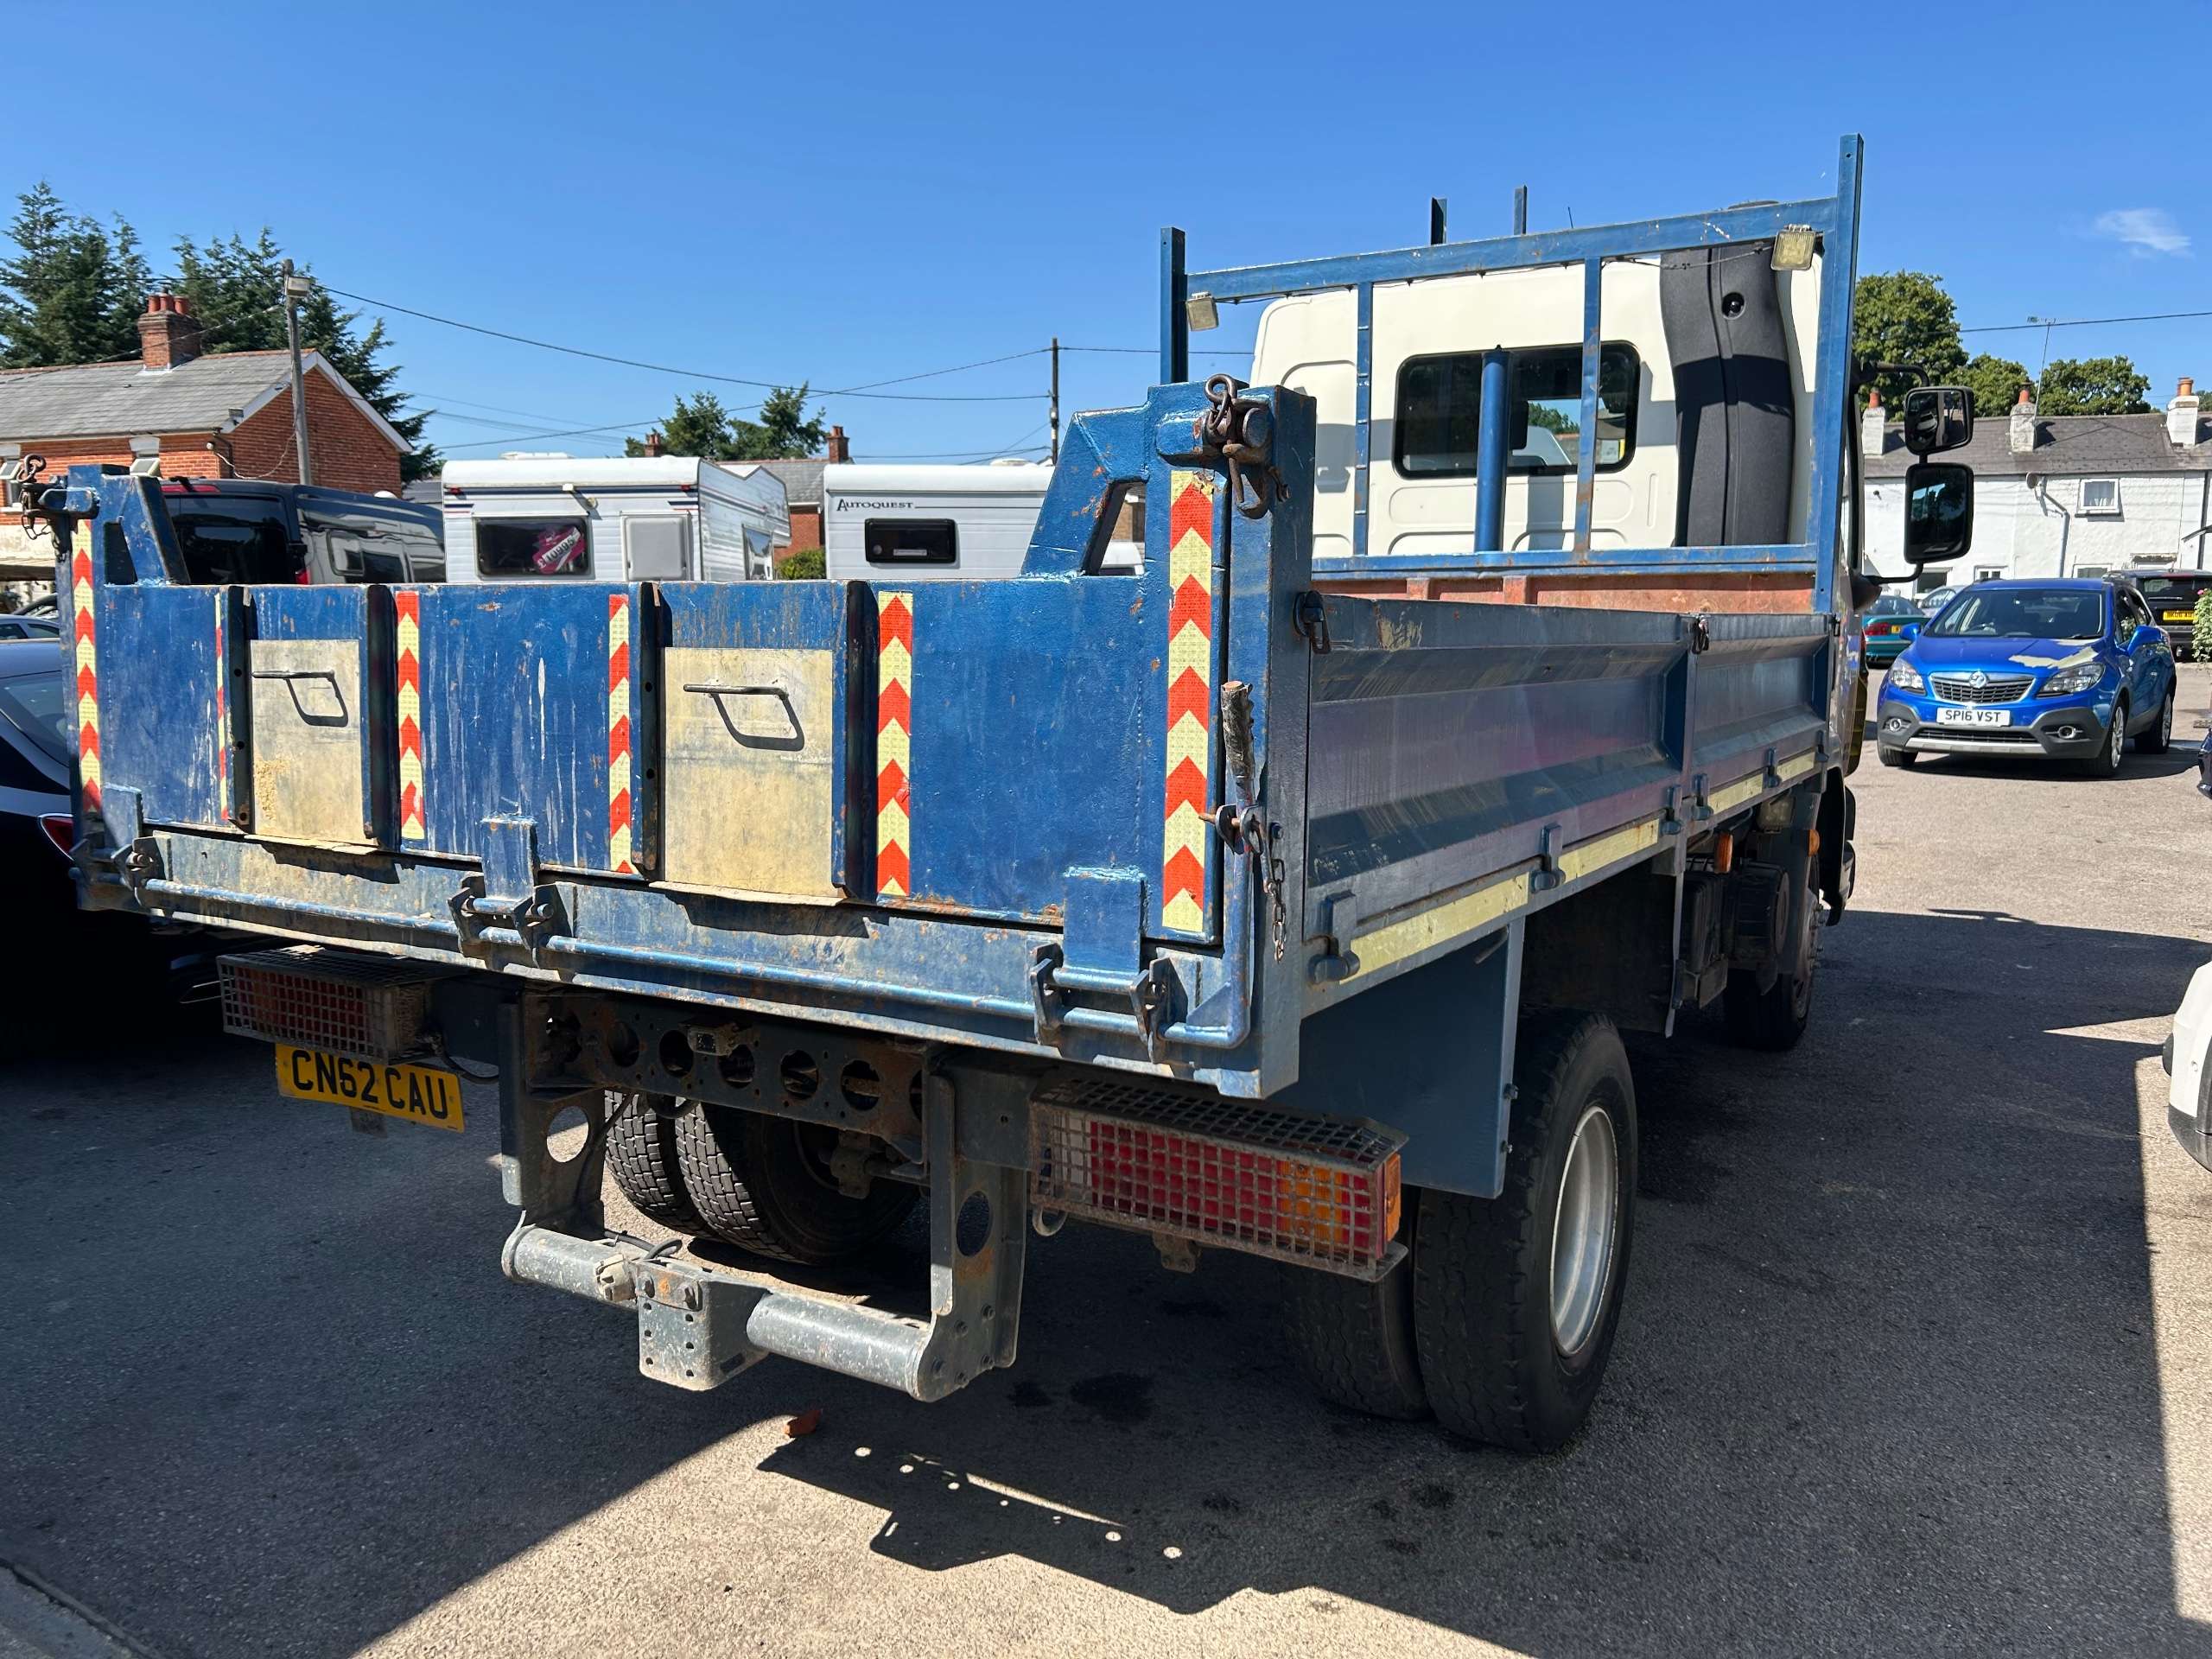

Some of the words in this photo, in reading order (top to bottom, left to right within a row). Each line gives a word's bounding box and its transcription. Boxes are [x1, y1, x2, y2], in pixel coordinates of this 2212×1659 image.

[1945, 709, 1973, 721] SP16
[1977, 711, 2001, 722] VST
[291, 1050, 378, 1103] CN62
[385, 1067, 448, 1120] CAU
